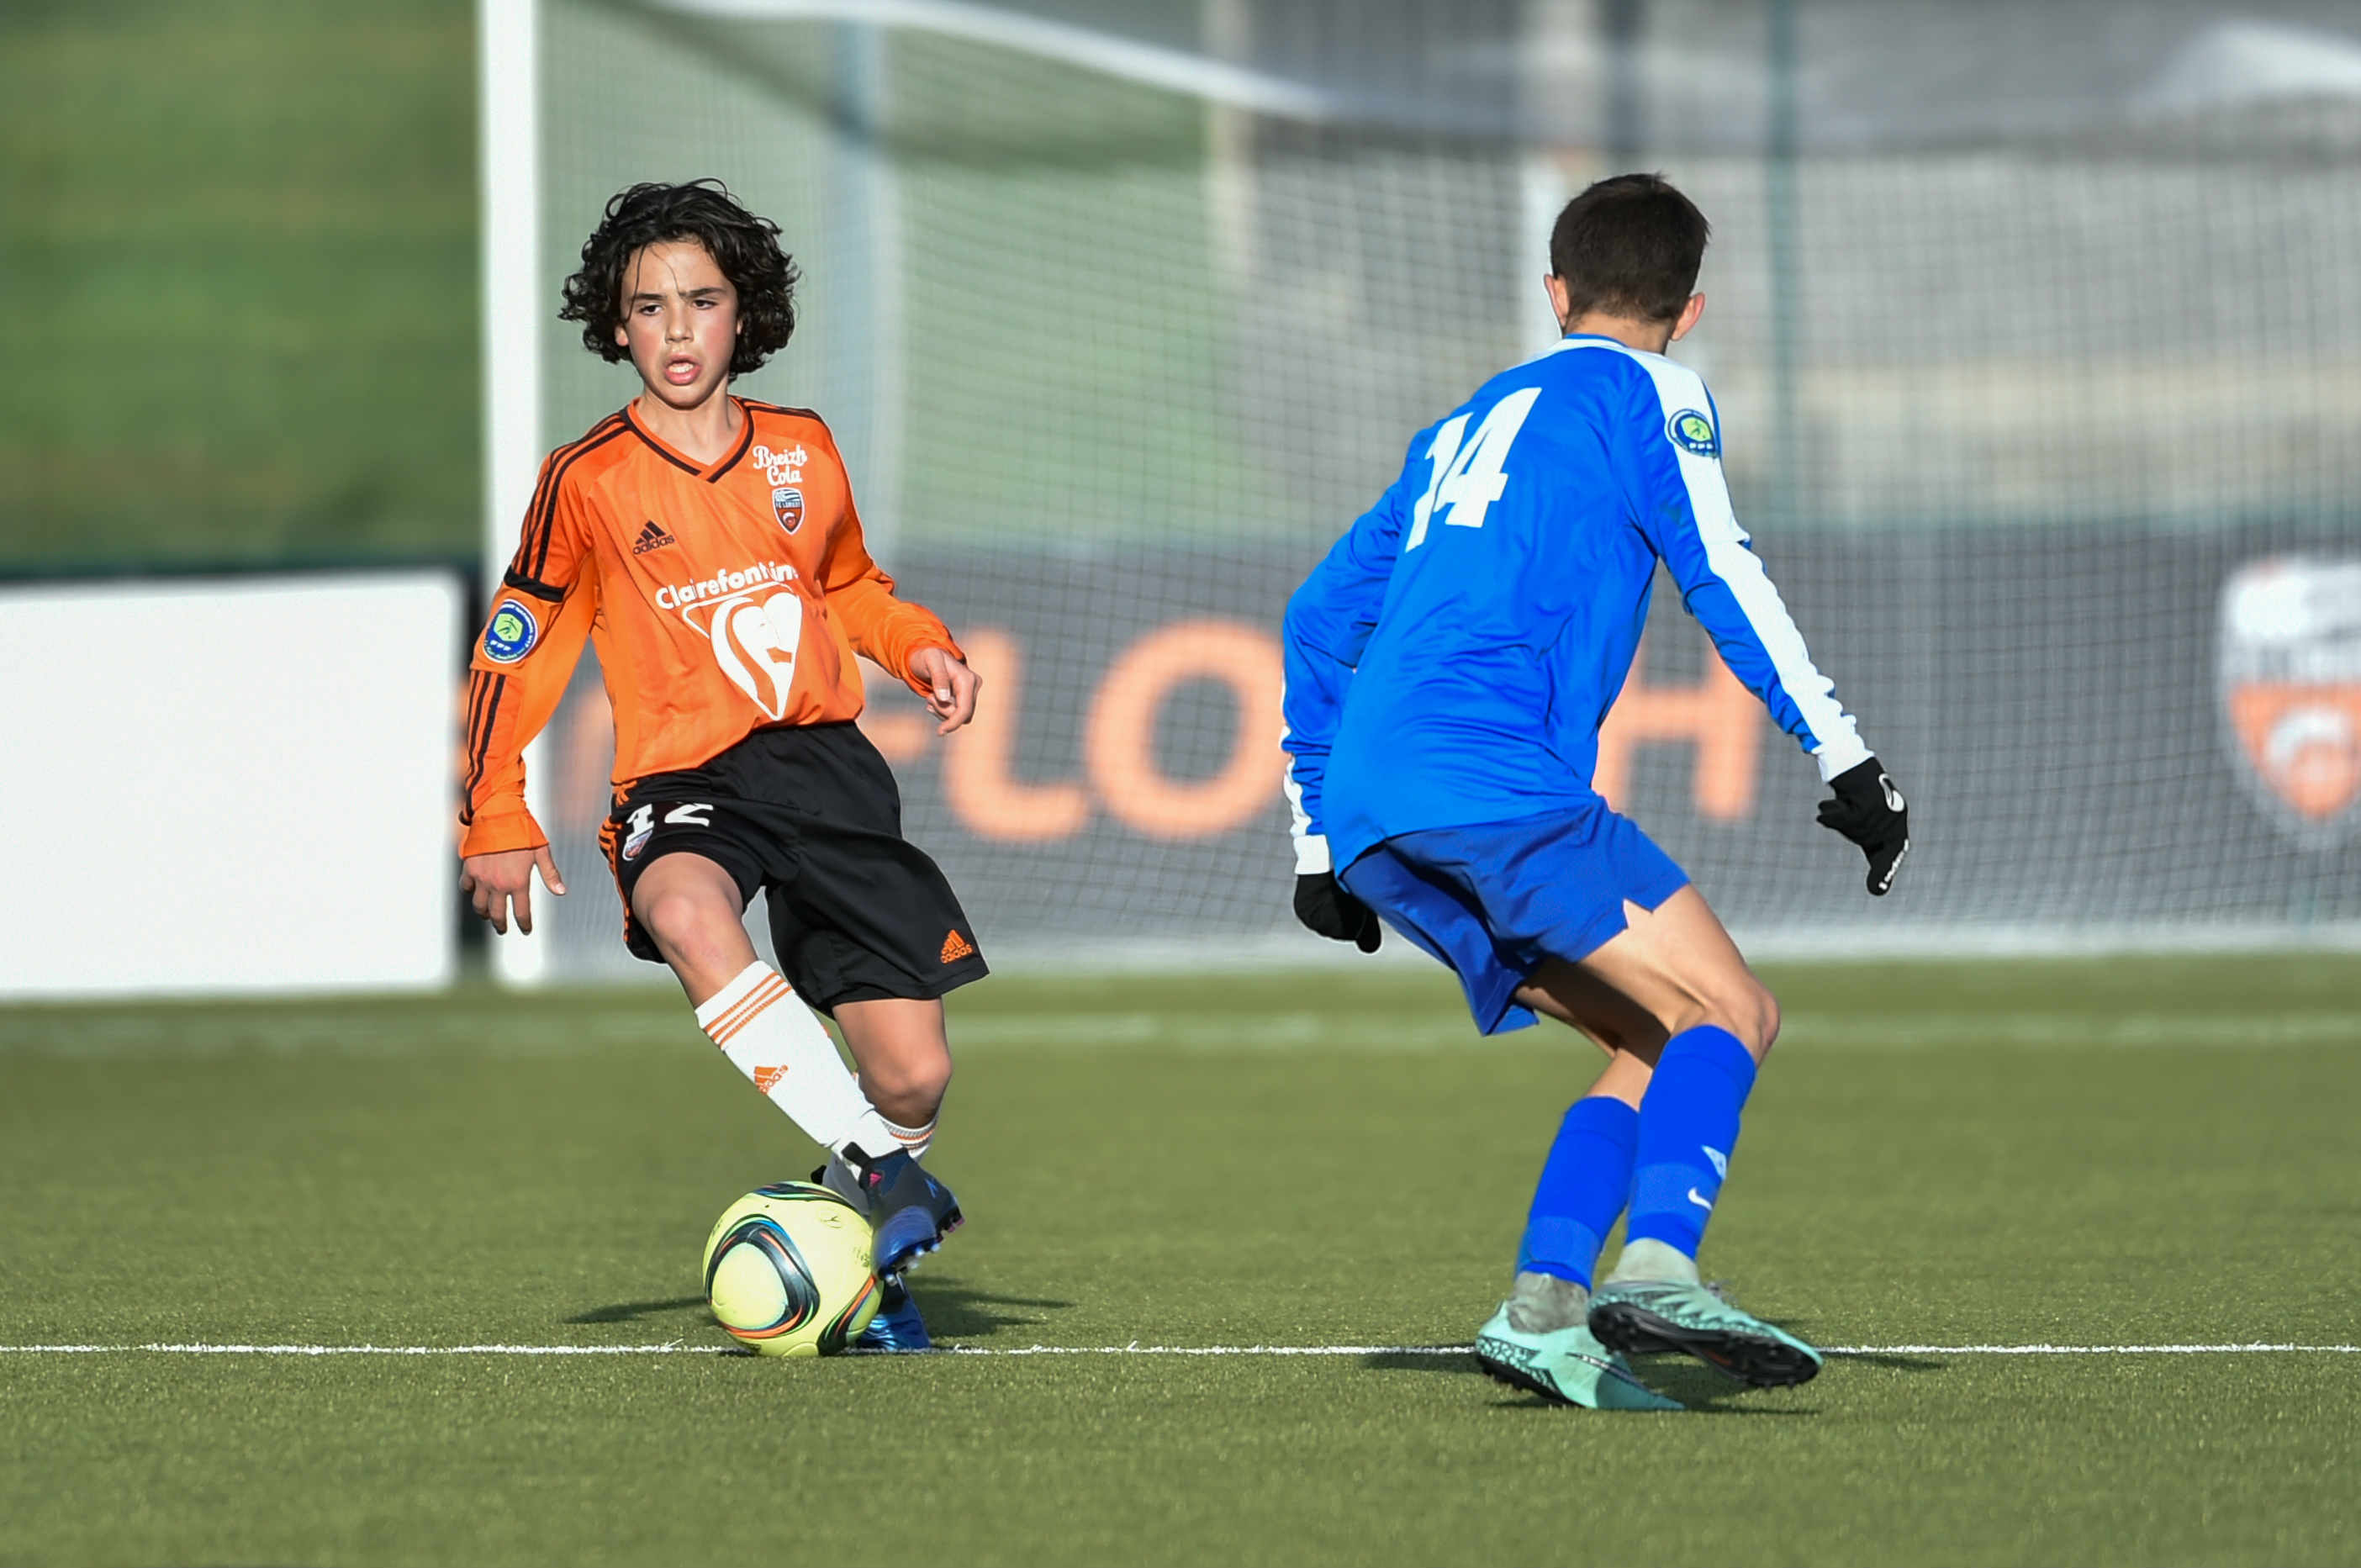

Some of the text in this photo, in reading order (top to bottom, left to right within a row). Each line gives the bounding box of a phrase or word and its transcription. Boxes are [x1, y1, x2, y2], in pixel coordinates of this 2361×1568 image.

[753, 443, 808, 470] Breizh
[766, 464, 803, 487] Cola
[1404, 387, 1543, 554] 14
[632, 535, 675, 555] adidas
[655, 560, 799, 610] Clairefontin
[940, 943, 973, 964] adidas
